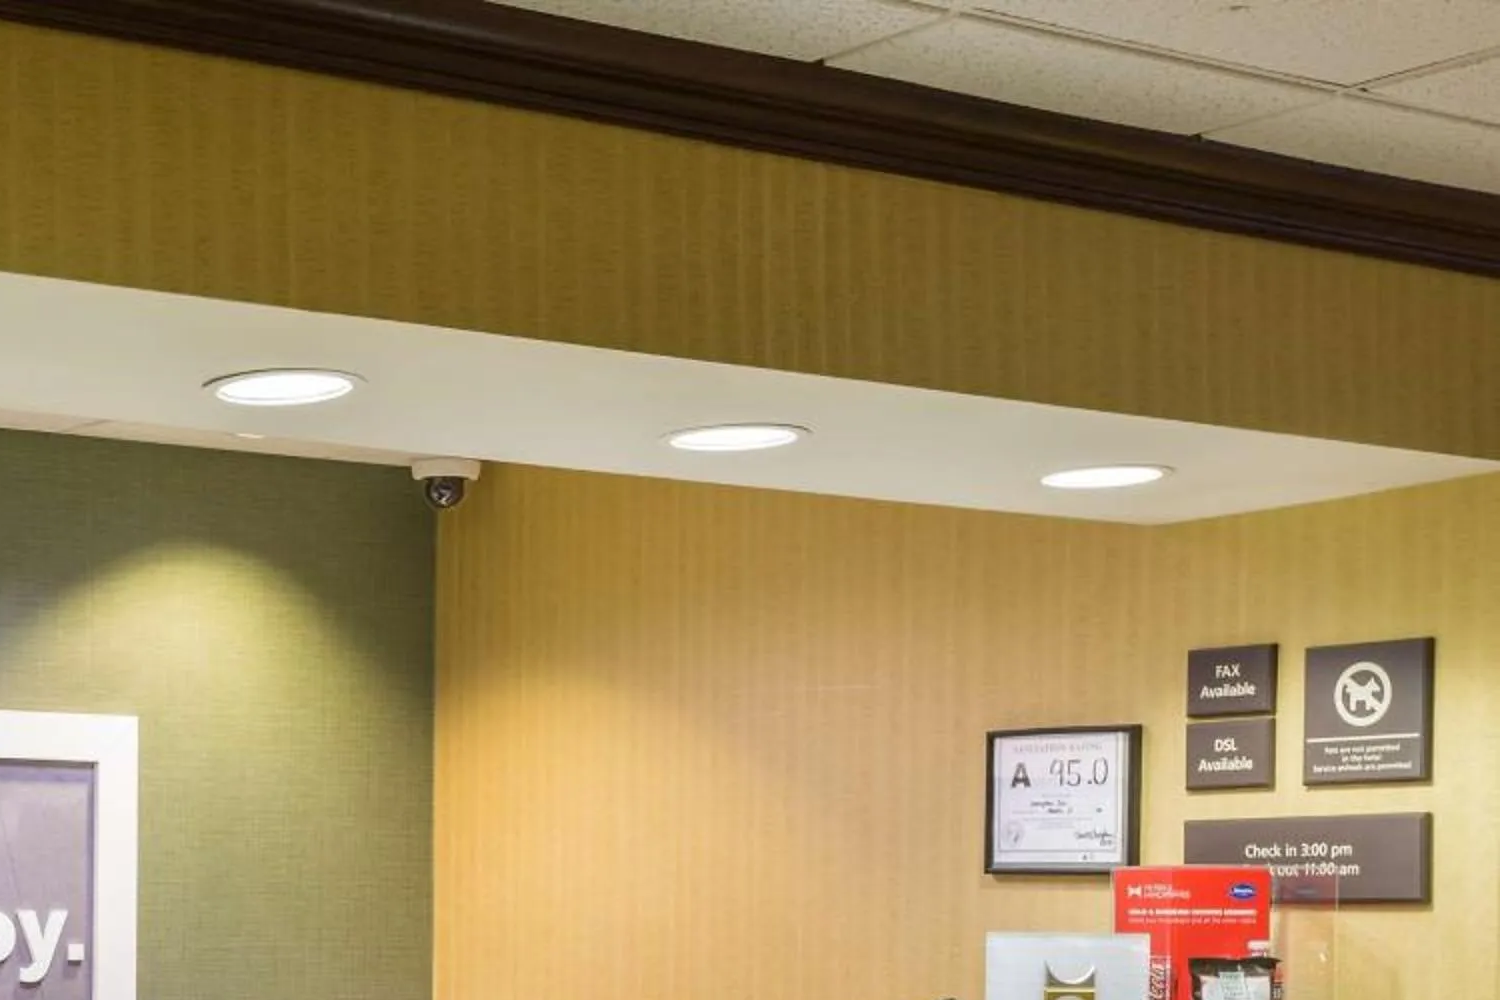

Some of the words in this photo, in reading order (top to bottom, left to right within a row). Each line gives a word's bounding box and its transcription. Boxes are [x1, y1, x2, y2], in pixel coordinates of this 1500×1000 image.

[1215, 664, 1241, 678] FAX
[1200, 682, 1257, 699] Available
[1214, 738, 1238, 752] DSL
[1198, 756, 1253, 772] Available
[1011, 762, 1031, 788] A
[1050, 757, 1109, 787] 95.0
[1245, 843, 1282, 858] Check
[1285, 843, 1297, 857] in
[1301, 842, 1328, 857] 3:00
[1331, 844, 1353, 859] pm
[1277, 864, 1300, 877] out
[1304, 861, 1335, 877] 11:00
[1339, 864, 1360, 876] am
